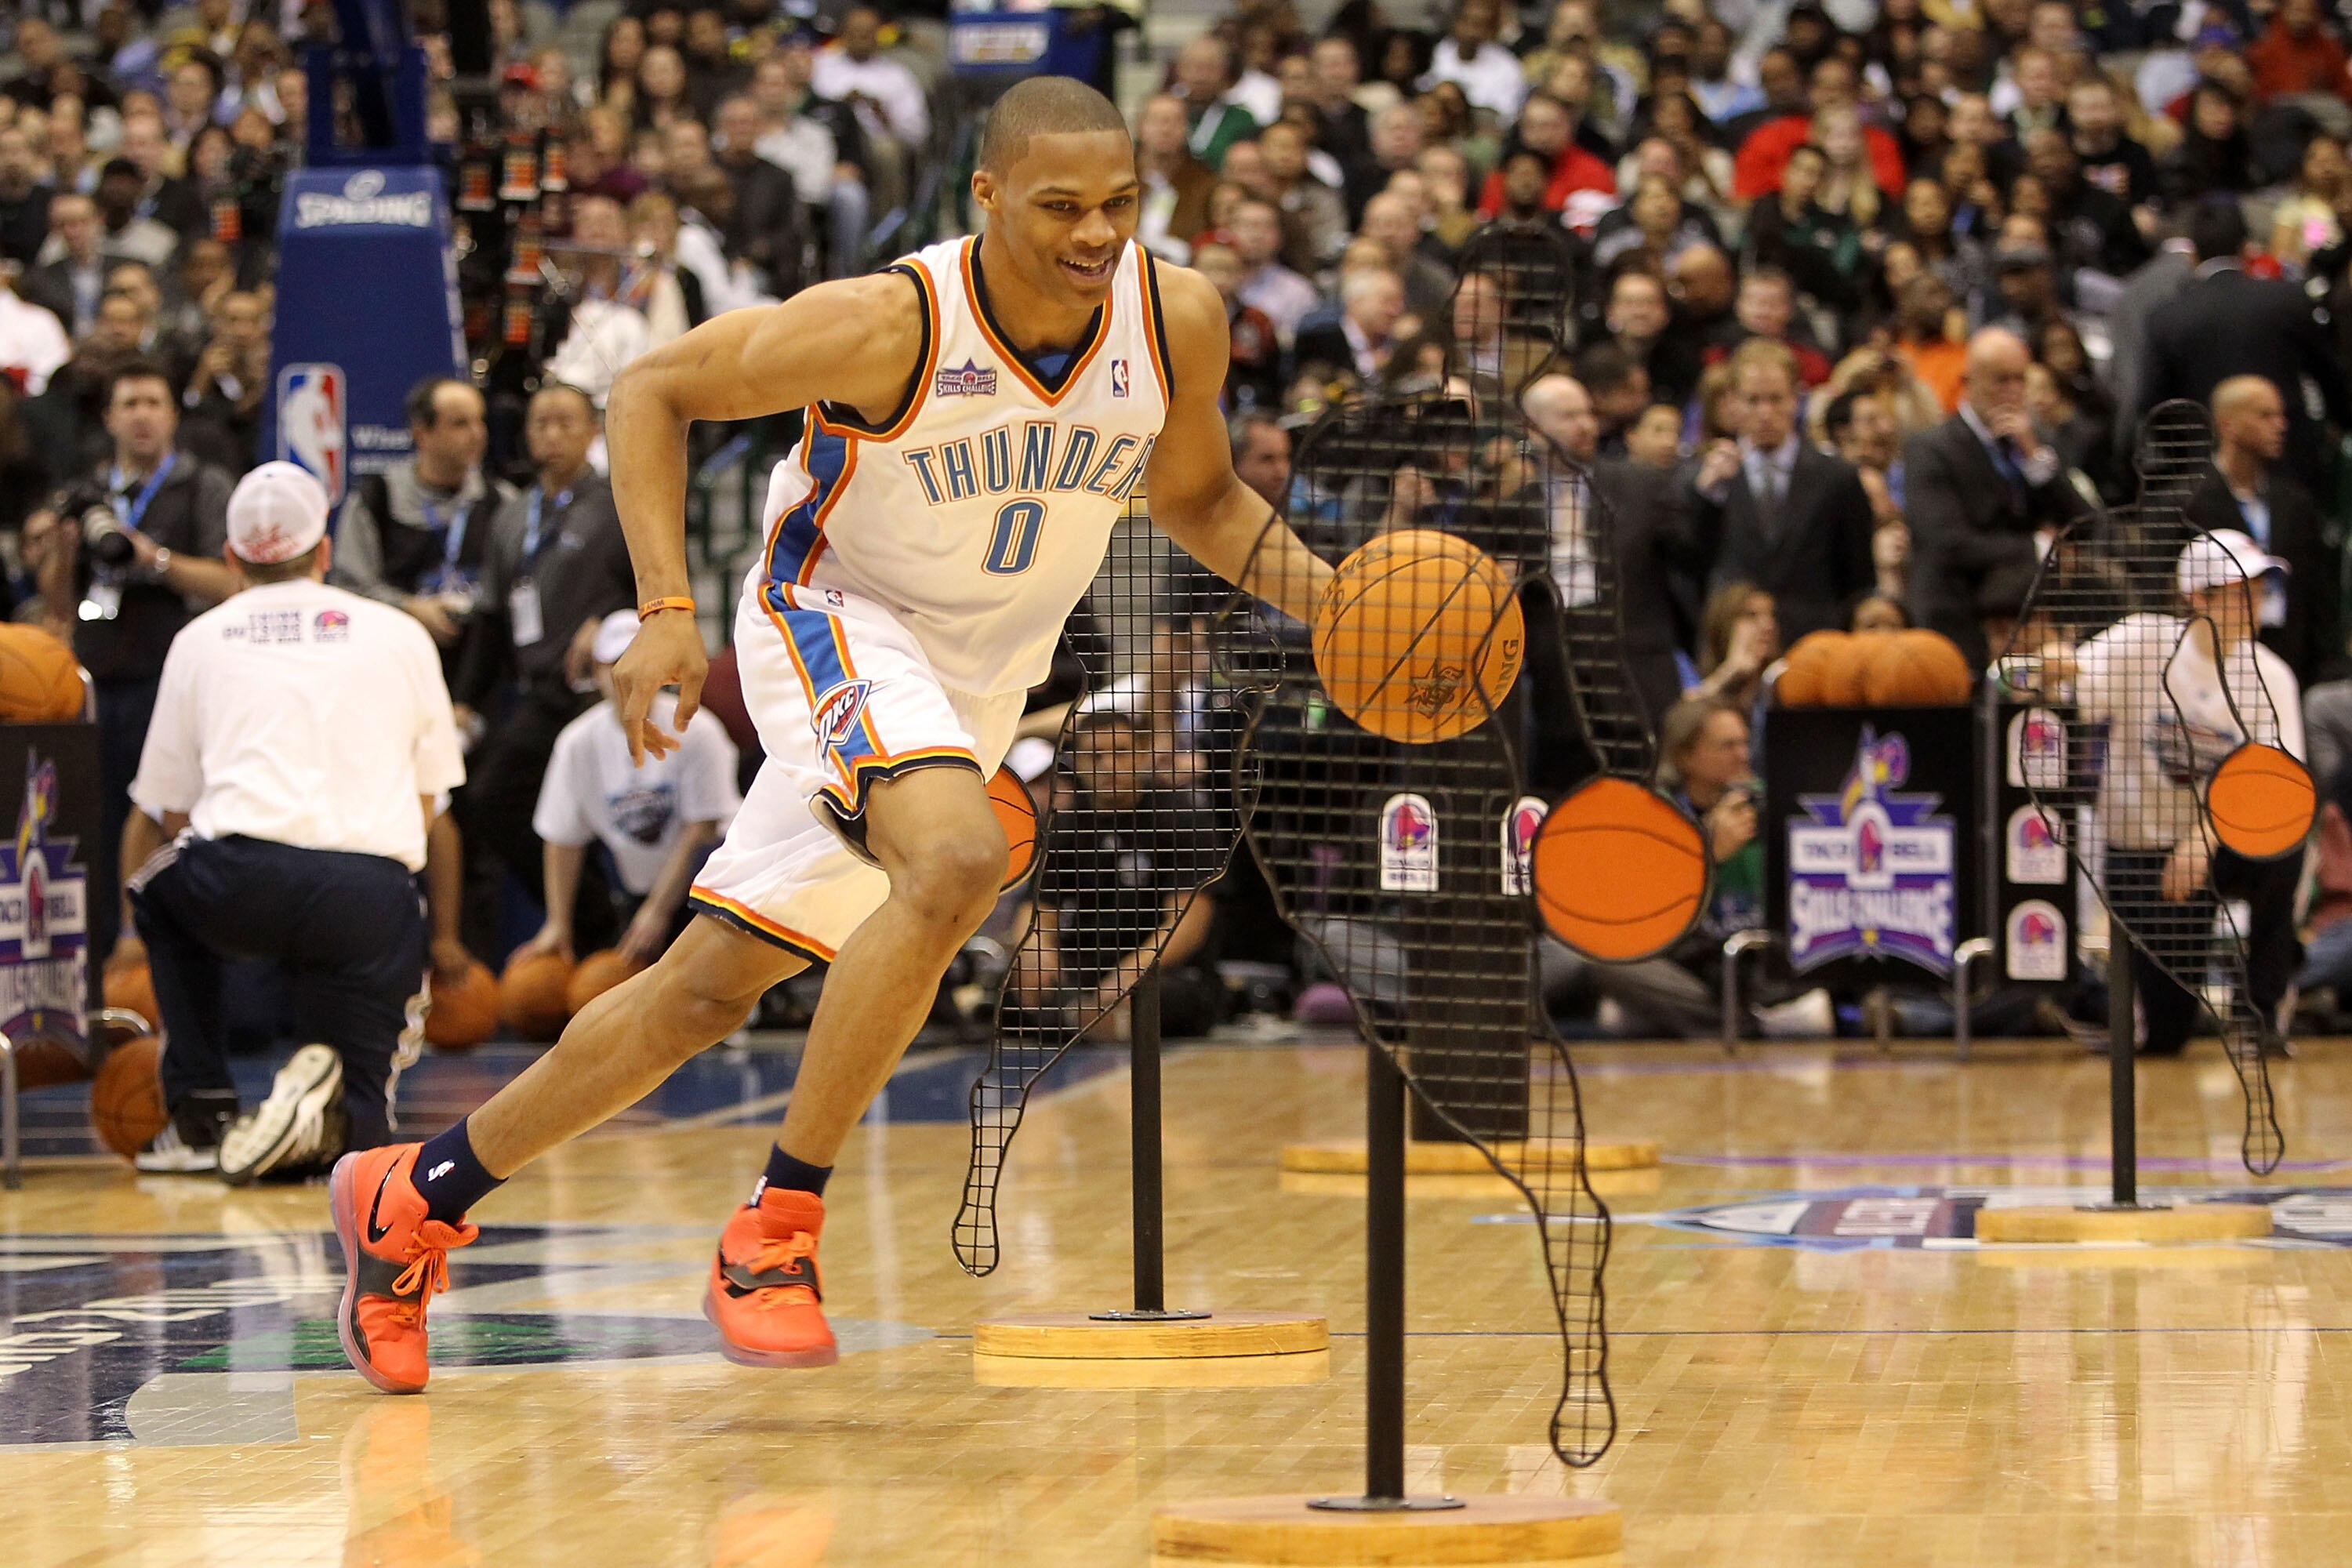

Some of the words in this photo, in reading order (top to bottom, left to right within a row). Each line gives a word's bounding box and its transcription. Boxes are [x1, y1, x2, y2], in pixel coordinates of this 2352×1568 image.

[296, 192, 431, 228] SPALDING
[938, 383, 961, 396] SKILLS
[902, 421, 1156, 506] THUNDER
[981, 496, 1048, 578] 0
[818, 688, 855, 760] OKC
